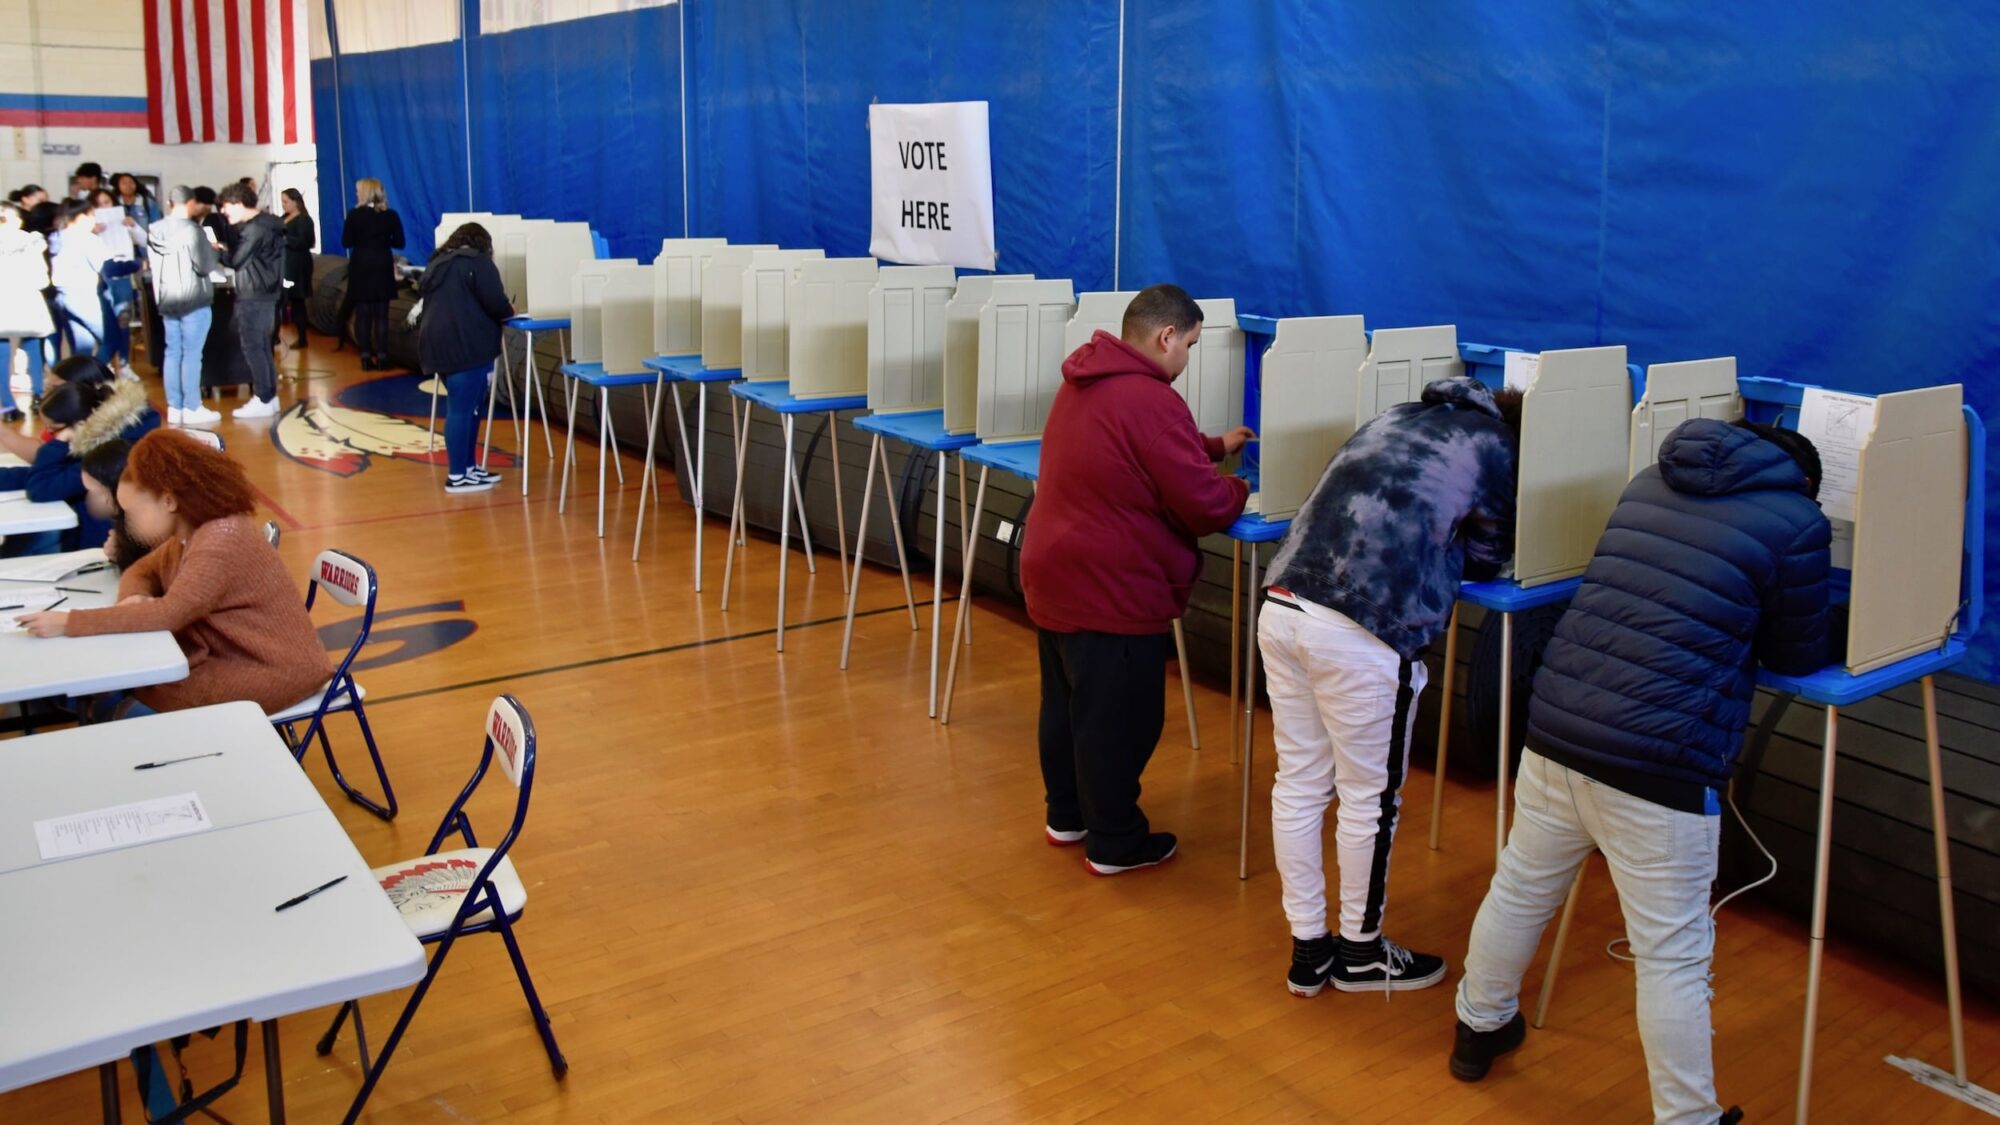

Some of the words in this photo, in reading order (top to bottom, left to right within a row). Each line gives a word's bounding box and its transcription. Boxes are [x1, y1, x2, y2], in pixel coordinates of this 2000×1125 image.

[898, 141, 948, 171] VOTE
[901, 200, 952, 231] HERE
[320, 560, 360, 596] WARRIORS
